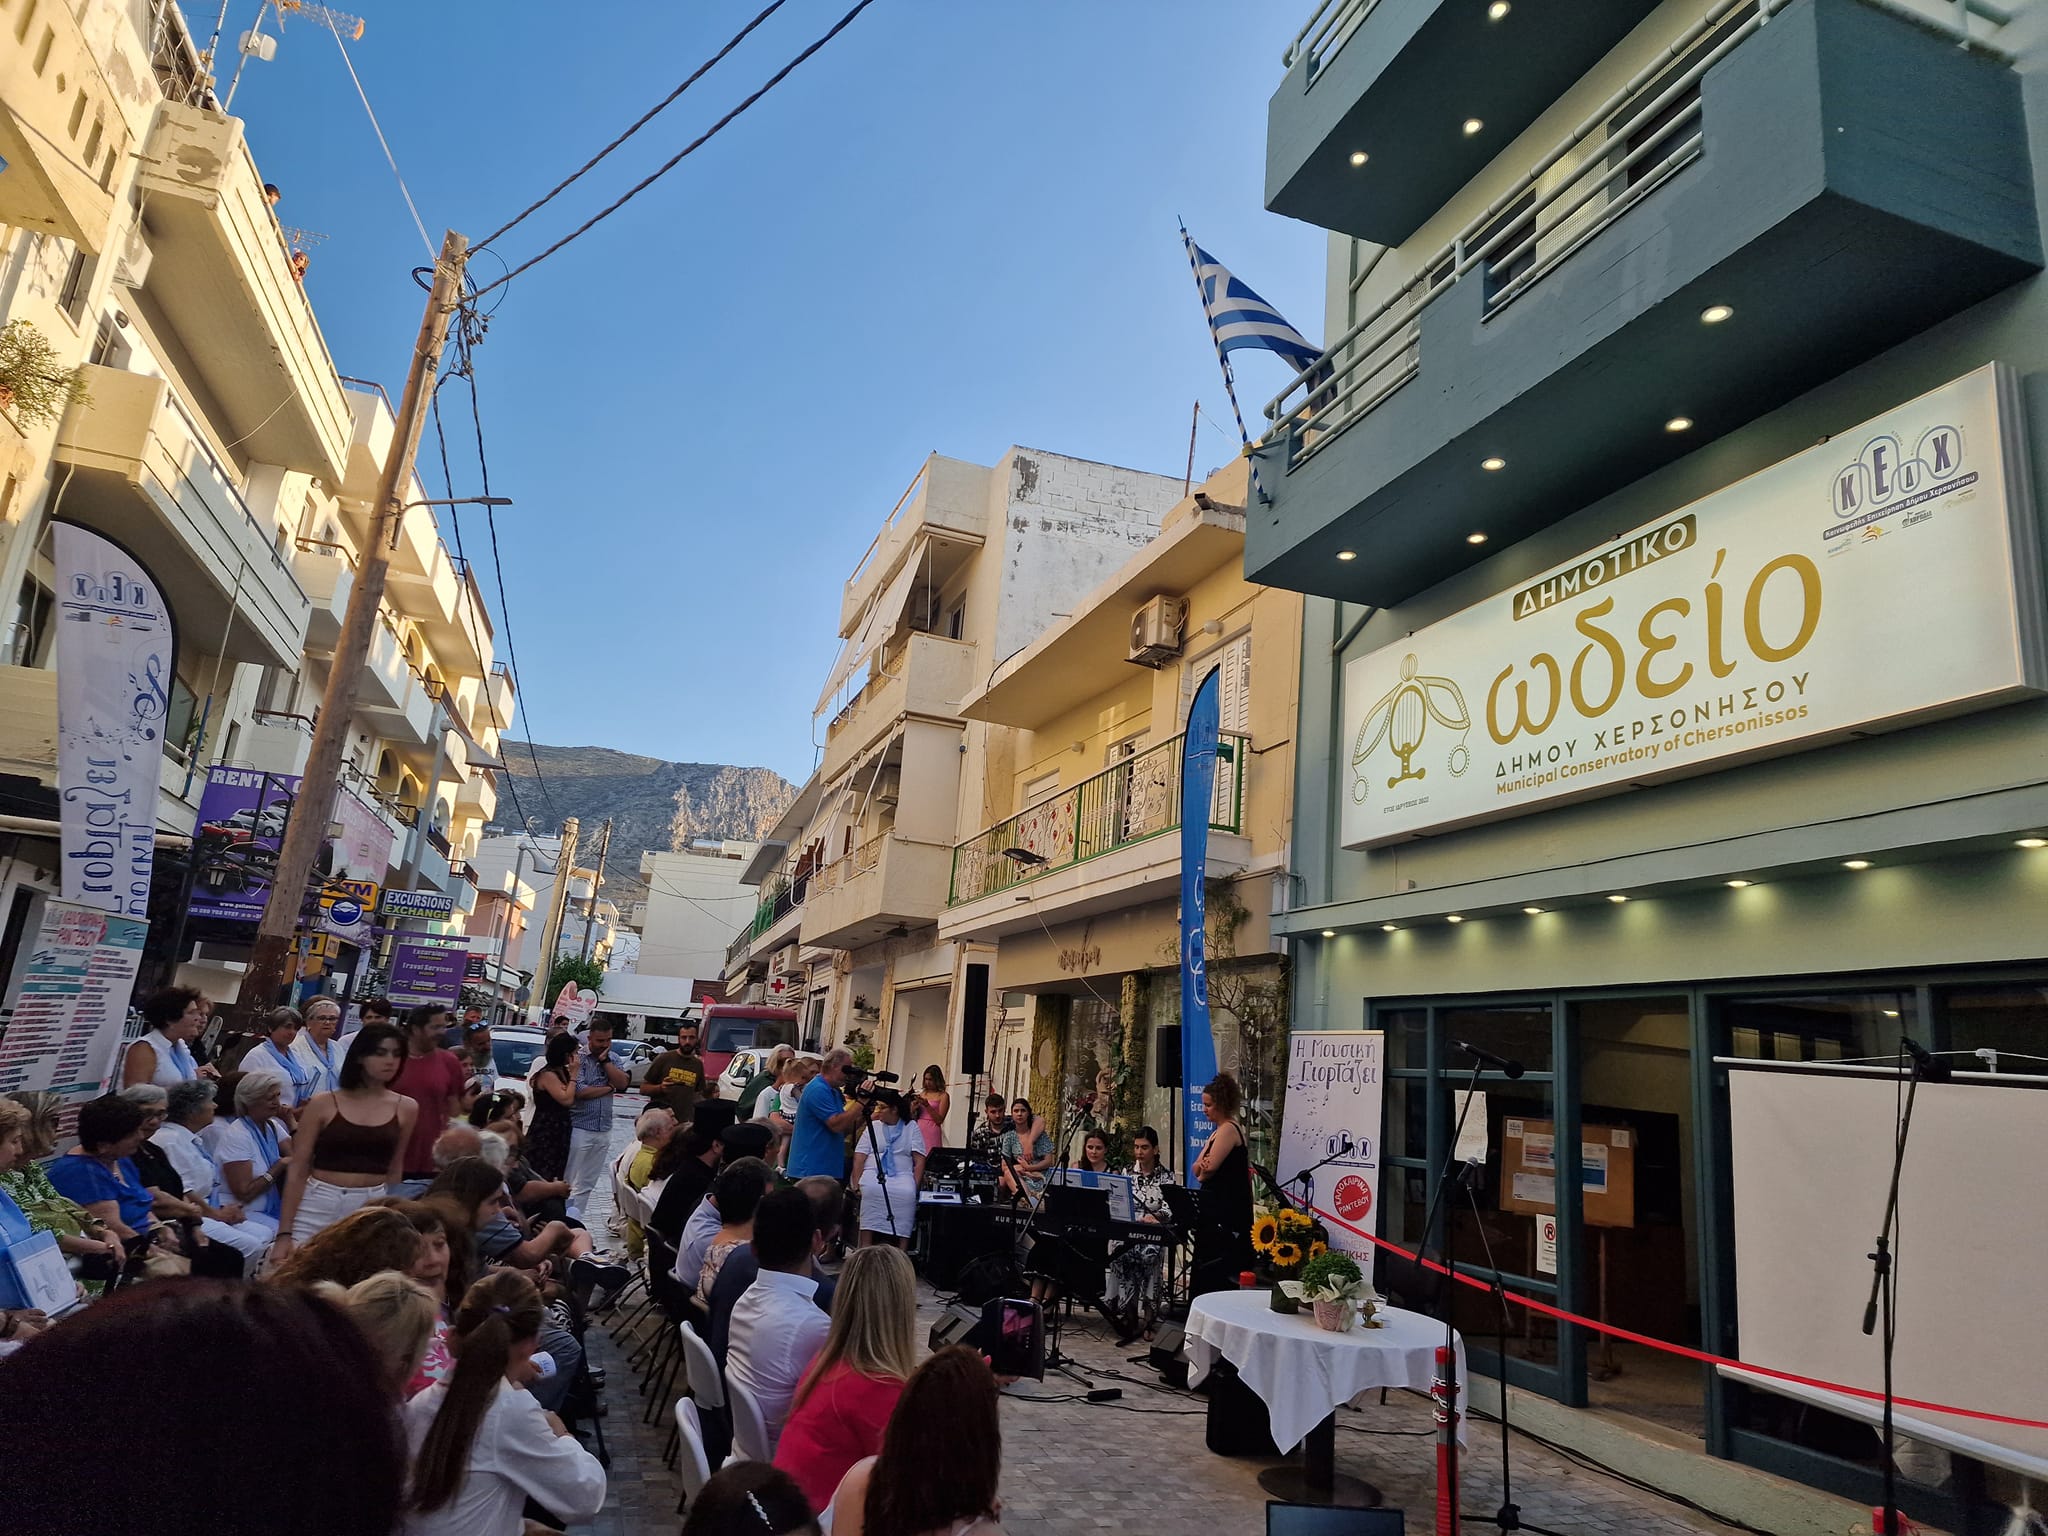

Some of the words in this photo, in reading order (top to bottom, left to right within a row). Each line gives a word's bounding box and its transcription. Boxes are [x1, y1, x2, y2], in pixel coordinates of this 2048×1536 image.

[1906, 491, 1929, 508] Δήμου
[1520, 522, 1688, 617] ΔΗΜΟΤΙΚΟ
[1486, 548, 1822, 745] ωδείο
[1495, 739, 1578, 778] ΔΗΜΟΥ
[1594, 672, 1810, 751] ΧΕΡΣΟΝΗΣΟΥ
[1496, 767, 1558, 795] Municipal
[1560, 741, 1660, 779] Conservatory
[1664, 733, 1681, 752] of
[1683, 703, 1809, 747] Chersonissos
[211, 768, 265, 791] RENT
[384, 903, 450, 920] EXCHANGE
[386, 891, 452, 911] EXCURSIONS
[1296, 1039, 1306, 1058] Η
[1311, 1038, 1376, 1064] Μουσική
[1300, 1059, 1377, 1095] Γιορτάζει
[1338, 1196, 1370, 1214] ΡΑΝΤΕΒΟΥ
